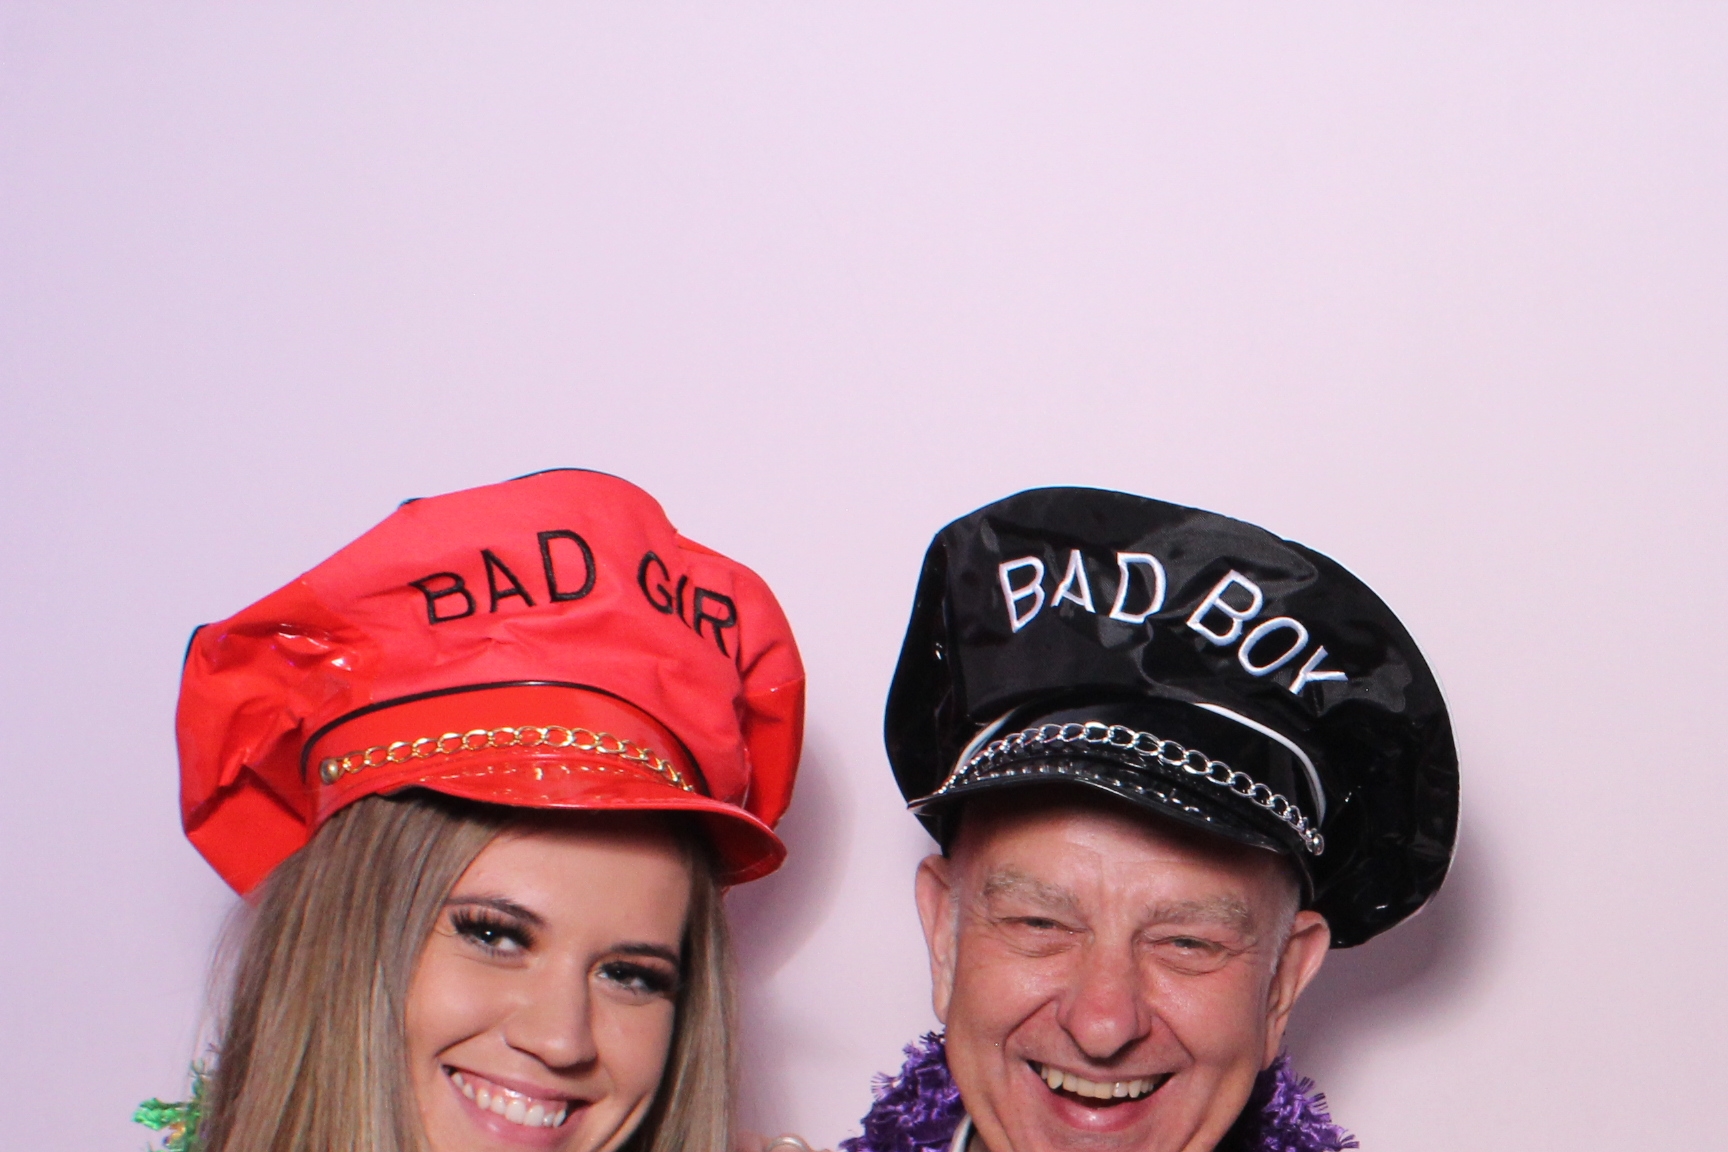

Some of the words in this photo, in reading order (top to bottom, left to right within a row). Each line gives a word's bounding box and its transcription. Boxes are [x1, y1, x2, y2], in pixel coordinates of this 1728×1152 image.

[408, 529, 597, 625] BAD
[636, 550, 738, 659] GIR
[999, 549, 1167, 634] BAD
[1186, 569, 1349, 695] BOY
